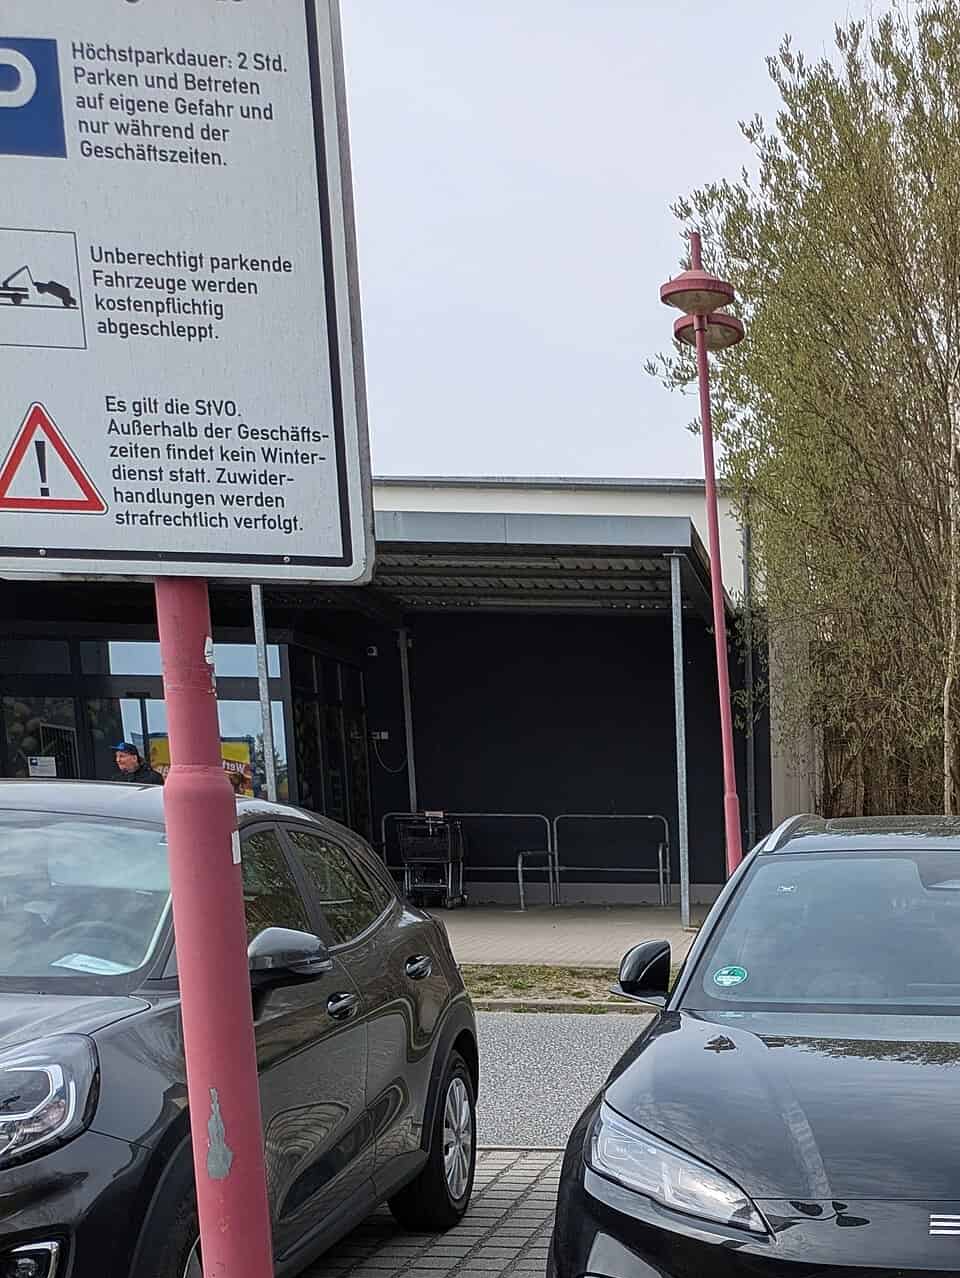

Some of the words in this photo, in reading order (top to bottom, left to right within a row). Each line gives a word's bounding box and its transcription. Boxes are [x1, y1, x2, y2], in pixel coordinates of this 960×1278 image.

[72, 42, 232, 68] Höchstparkdauer:
[237, 52, 248, 70] 2
[253, 53, 287, 72] Std.
[74, 66, 138, 87] Parken
[145, 72, 178, 90] und
[184, 73, 260, 95] Betreten
[76, 93, 104, 110] auf
[109, 93, 168, 116] eigene
[175, 97, 234, 117] Gefahr
[240, 103, 273, 120] und
[79, 120, 110, 134] nur
[114, 119, 194, 139] während
[201, 123, 230, 142] der
[80, 140, 227, 166] Geschäftszeiten.
[90, 245, 203, 272] Unberechtigt
[210, 254, 292, 273] parkende
[93, 270, 186, 294] Fahrzeuge
[191, 277, 257, 295] werden
[95, 293, 223, 320] kostenpflichtig
[97, 317, 219, 342] abgeschleppt.
[105, 396, 127, 412] Es
[132, 397, 158, 417] gilt
[165, 398, 189, 414] die
[195, 400, 241, 416] StVO.
[107, 418, 198, 437] Außerhalb
[204, 422, 232, 439] der
[238, 424, 329, 442] Geschäfts-
[109, 442, 160, 459] zeiten
[166, 444, 214, 461] findet
[220, 445, 256, 463] kein
[261, 447, 326, 464] Winter-
[112, 464, 164, 481] dienst
[169, 467, 210, 483] statt.
[216, 468, 294, 486] Zuwider-
[113, 486, 215, 508] handlungen
[220, 491, 284, 508] werden
[116, 510, 228, 528] strafrechtlich
[233, 514, 303, 534] verfolgt.
